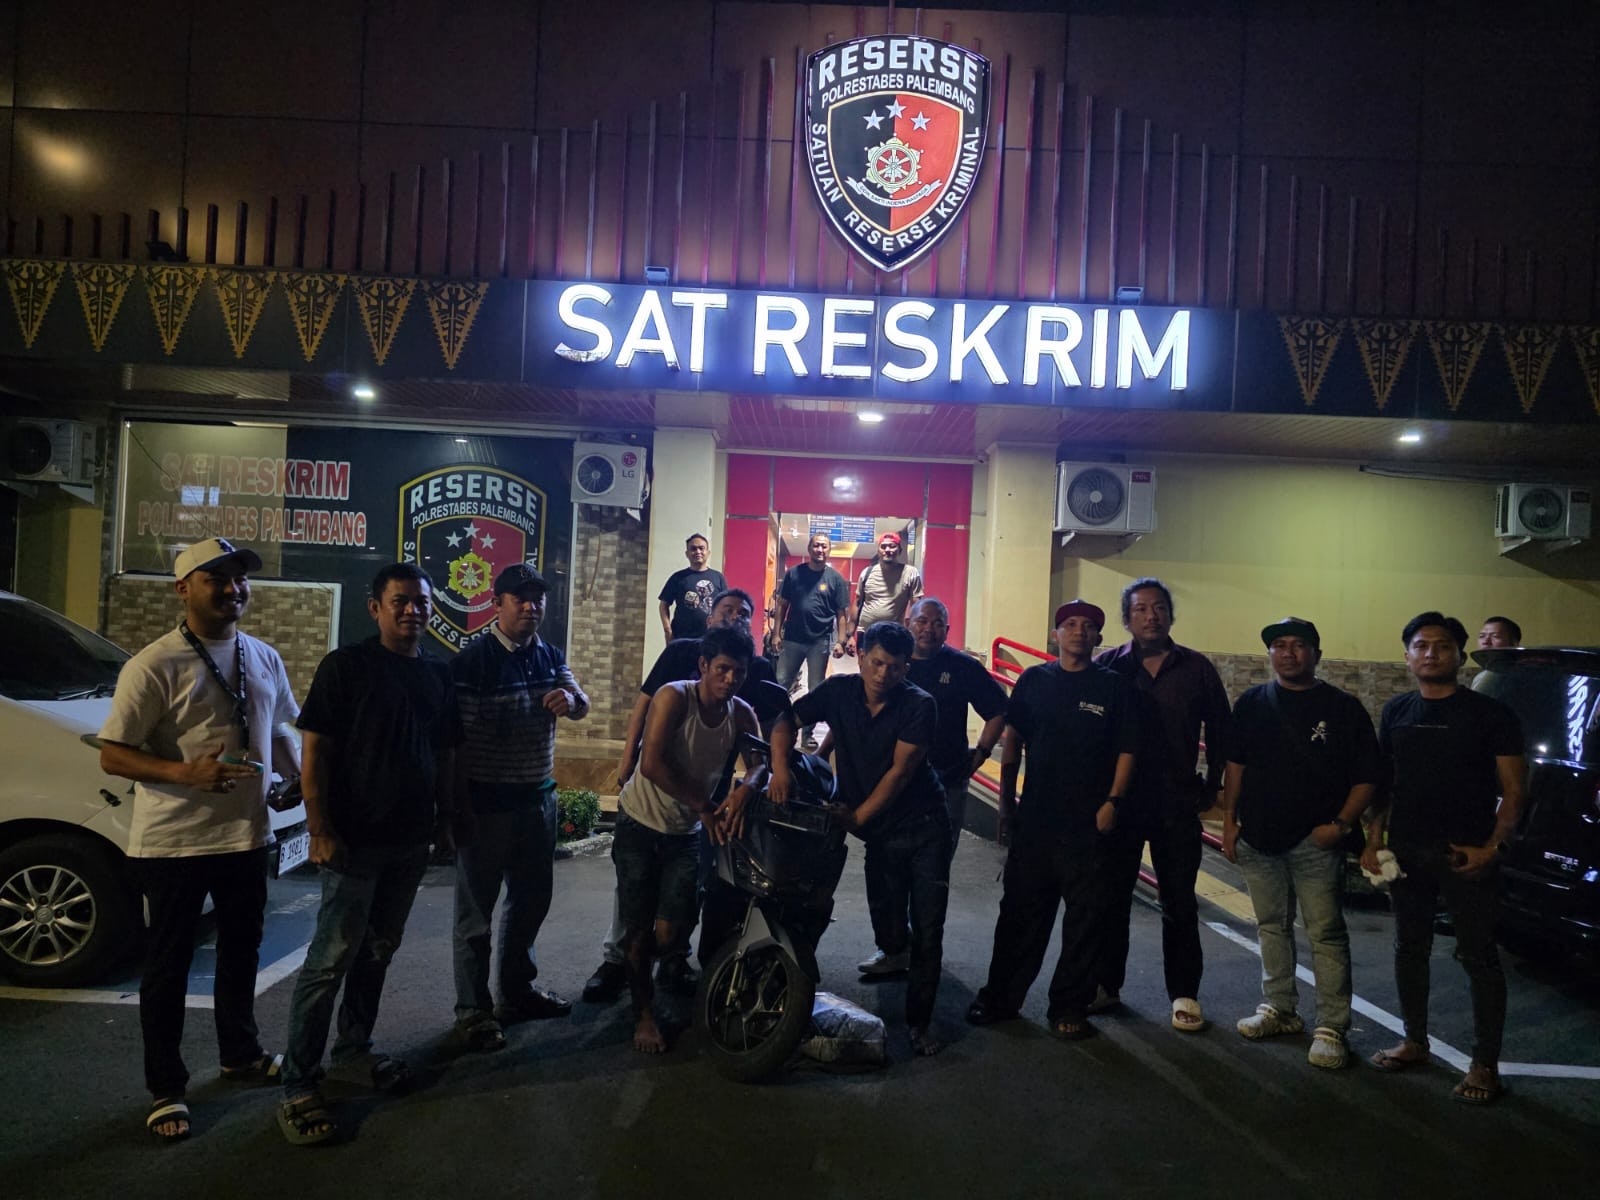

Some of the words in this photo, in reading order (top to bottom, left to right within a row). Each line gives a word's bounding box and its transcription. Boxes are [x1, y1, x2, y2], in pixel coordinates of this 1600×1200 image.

[818, 39, 978, 94] RESERSE
[821, 73, 904, 109] POLRESTABES
[906, 74, 975, 114] PALEMBANG
[812, 122, 844, 204] SATUAN
[843, 210, 937, 252] RESERSE
[936, 127, 980, 218] KRIMINAL
[553, 283, 729, 374] SAT
[752, 295, 1191, 391] RESKRIM
[160, 453, 215, 492] SAT
[217, 455, 350, 500] RESKRIM
[410, 473, 538, 520] RESERSE
[622, 469, 635, 478] LG
[137, 502, 258, 541] POLRESTABES
[260, 507, 367, 546] PALEMBANG
[412, 501, 478, 529] POLRESTABES
[480, 503, 535, 536] PALEMBANG
